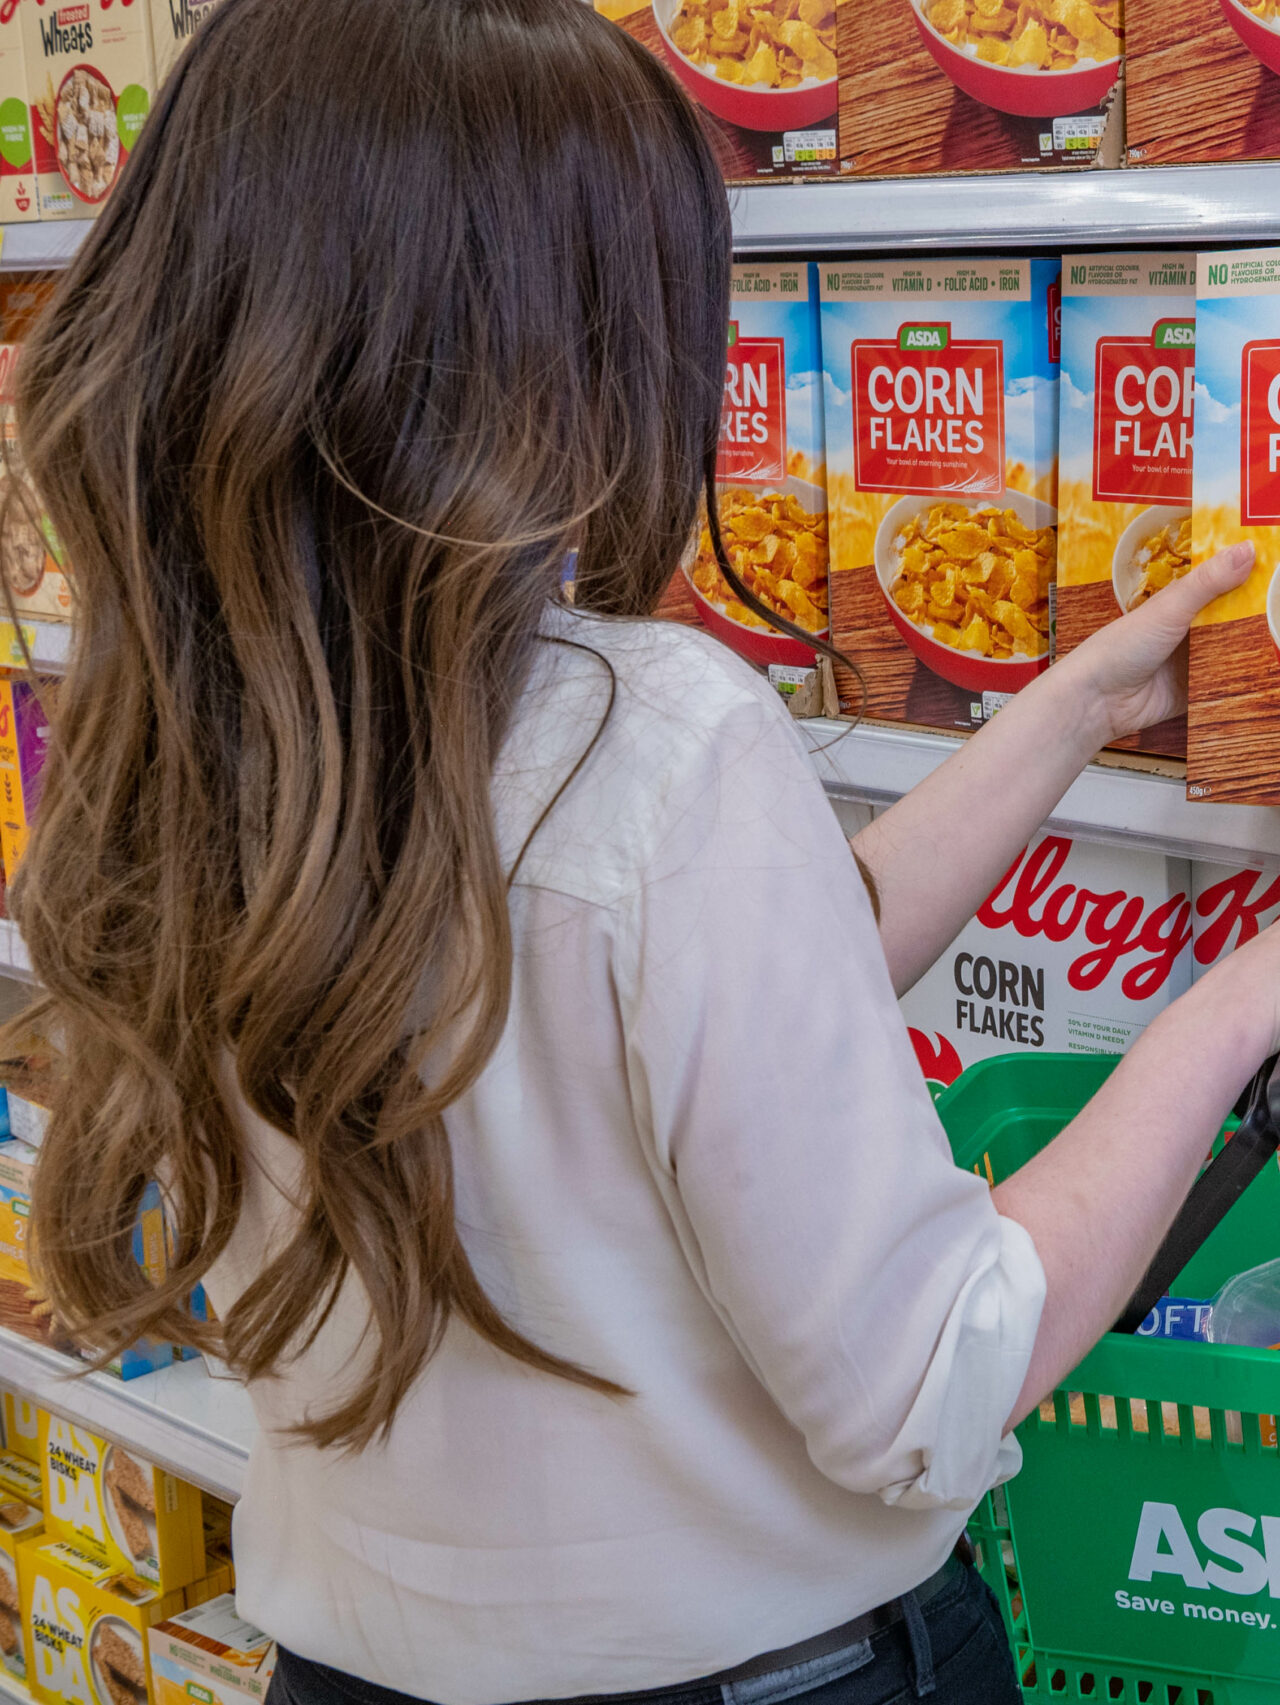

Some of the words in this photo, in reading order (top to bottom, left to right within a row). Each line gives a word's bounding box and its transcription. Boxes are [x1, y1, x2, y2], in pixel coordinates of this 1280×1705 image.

[169, 0, 214, 40] Whea
[40, 10, 93, 57] Wheats
[753, 279, 770, 292] ACID
[780, 279, 798, 292] IRON
[827, 273, 840, 291] NO
[892, 278, 924, 292] VITAMIN
[944, 278, 967, 292] FOLIC
[969, 278, 989, 291] ACID
[999, 277, 1020, 291] IRON
[1071, 266, 1086, 285] NO
[1149, 271, 1187, 286] VITAMIN
[1208, 264, 1228, 287] NO
[906, 330, 941, 347] ASDA
[868, 365, 983, 415] CORN
[870, 418, 984, 454] FLAKES
[1114, 420, 1195, 458] FLAK
[954, 952, 1045, 1011] CORN
[956, 999, 1045, 1047] FLAKES
[1112, 1027, 1131, 1037] DAILY
[1102, 1035, 1125, 1045] NEEDS
[1137, 1304, 1211, 1336] OFT
[49, 1442, 62, 1458] 24
[62, 1448, 97, 1475] WHEAT
[50, 1456, 77, 1481] BISKS
[1114, 1590, 1175, 1616] Save
[1183, 1601, 1278, 1630] money.
[33, 1613, 46, 1628] 24
[46, 1622, 83, 1649] WHEAT
[35, 1629, 64, 1655] BISKS
